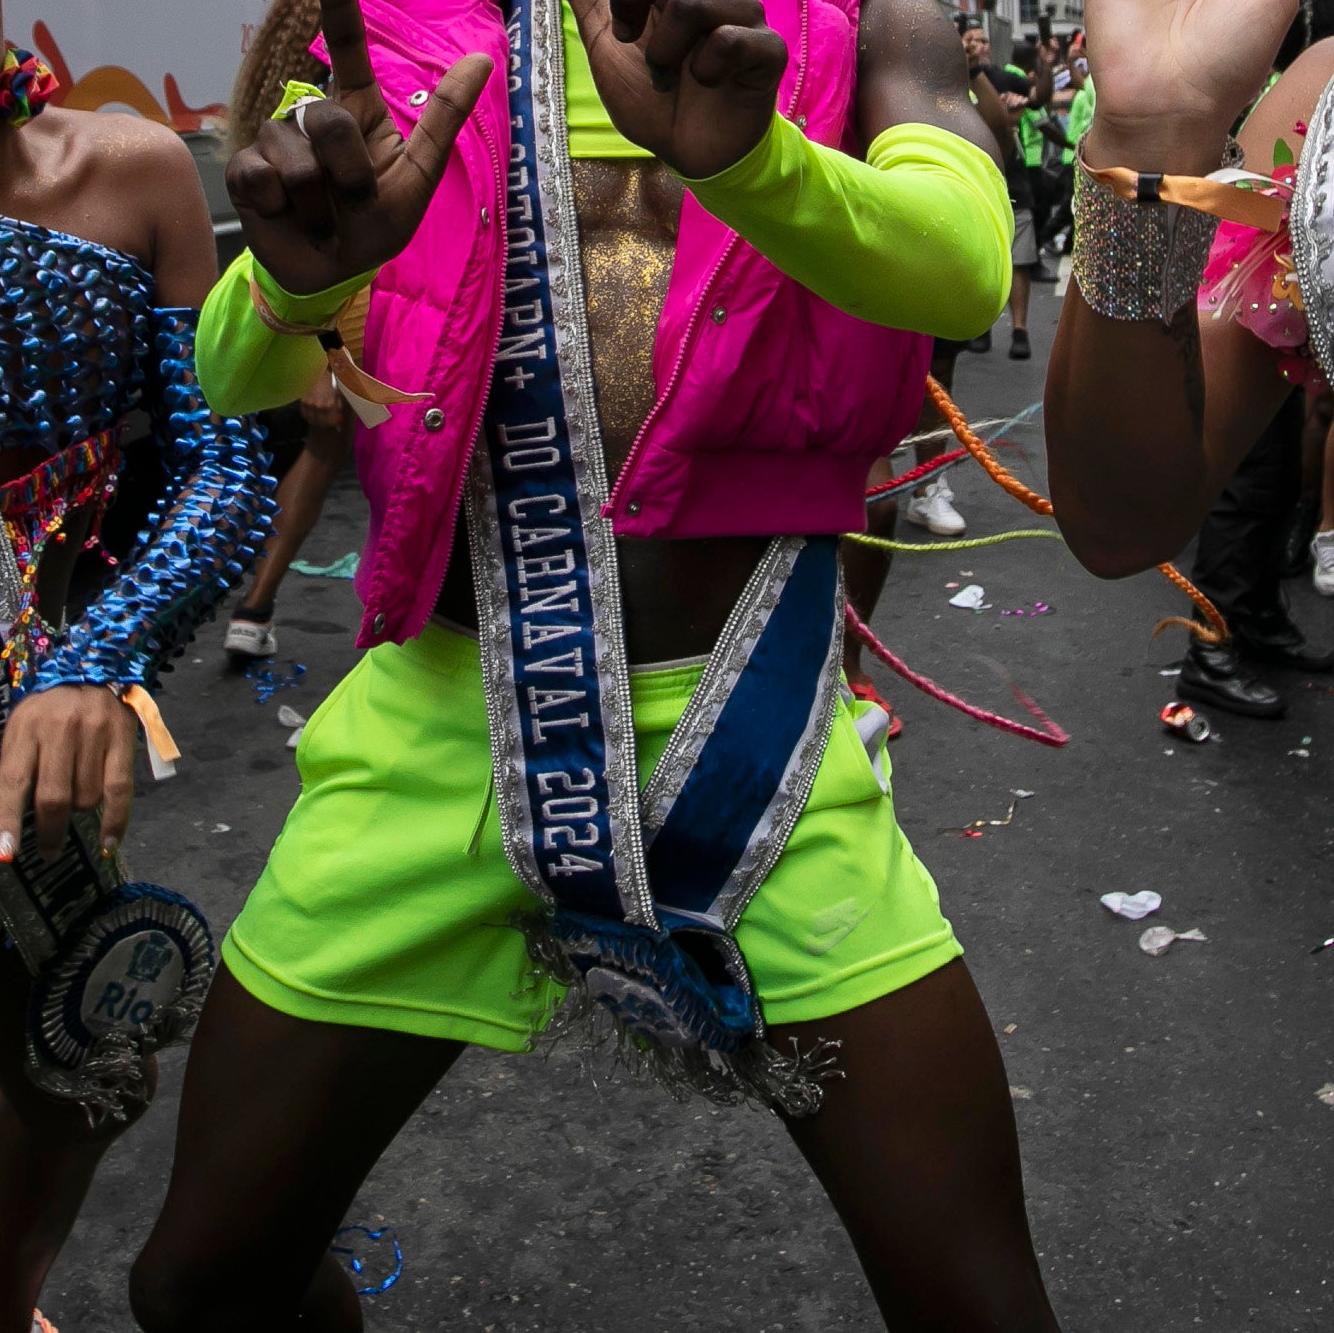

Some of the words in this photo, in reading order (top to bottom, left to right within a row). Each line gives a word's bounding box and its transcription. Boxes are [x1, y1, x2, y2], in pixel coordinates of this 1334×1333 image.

[497, 416, 560, 471] DO
[509, 493, 589, 746] CARNAVAL
[537, 767, 605, 878] 2024
[93, 980, 154, 1026] Rio
